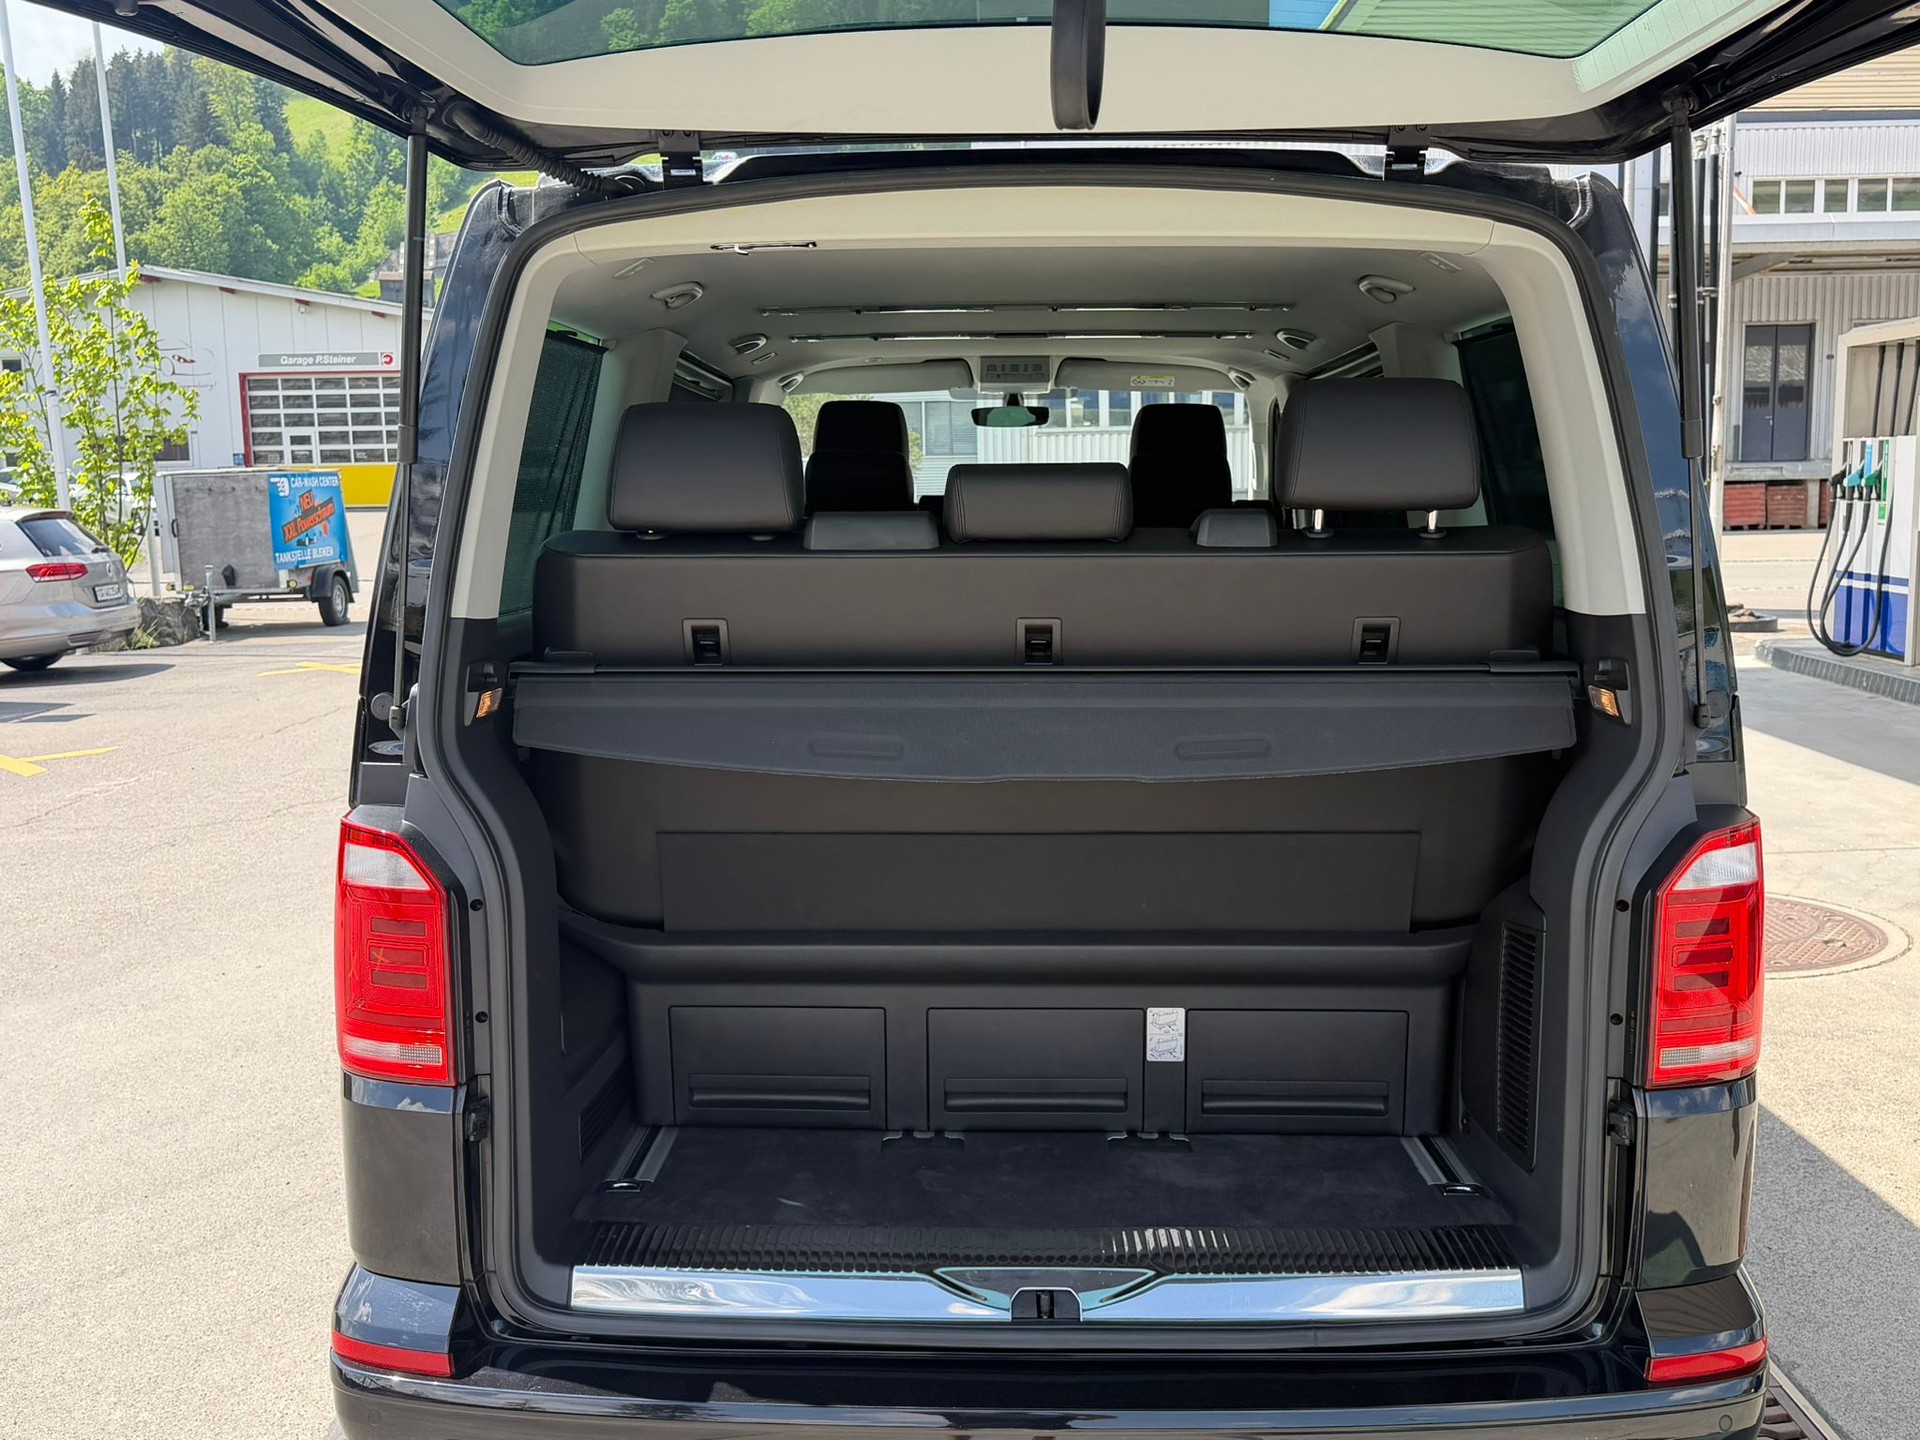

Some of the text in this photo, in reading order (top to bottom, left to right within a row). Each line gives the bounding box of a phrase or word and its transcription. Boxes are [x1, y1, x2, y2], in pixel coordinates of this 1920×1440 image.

[280, 355, 313, 366] Garage
[290, 475, 339, 488] CAR-WASH CENTER
[275, 548, 312, 563] TANKSTELLE
